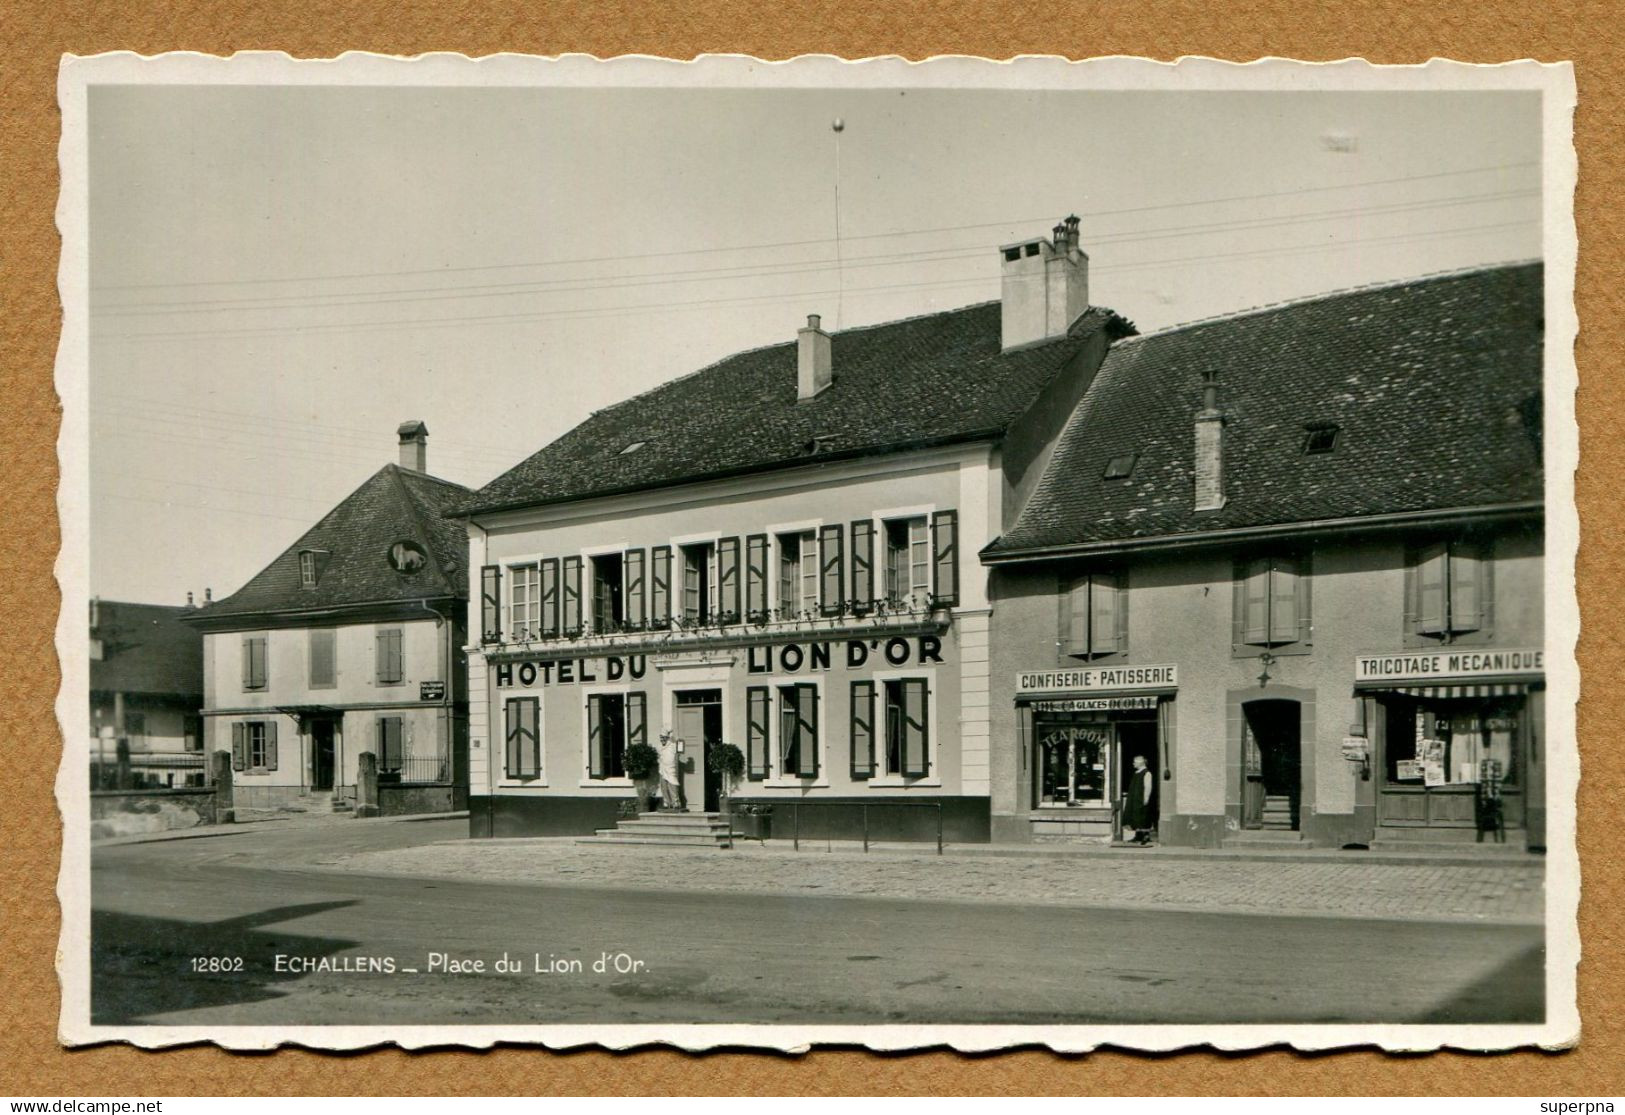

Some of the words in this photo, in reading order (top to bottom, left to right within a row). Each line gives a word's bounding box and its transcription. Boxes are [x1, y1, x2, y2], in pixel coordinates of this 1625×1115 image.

[496, 658, 597, 687] HOTEL
[607, 655, 647, 682] DU
[748, 642, 832, 674] LION
[847, 636, 946, 670] D'OR
[1362, 657, 1440, 675] TRICOTAGE
[1448, 652, 1543, 672] MECANIQUE
[1022, 672, 1092, 688] CONFISERIE
[1100, 668, 1174, 686] PATISSERIE
[1076, 700, 1108, 710] GLACES
[1040, 729, 1068, 748] TEA
[1070, 728, 1107, 749] ROOM
